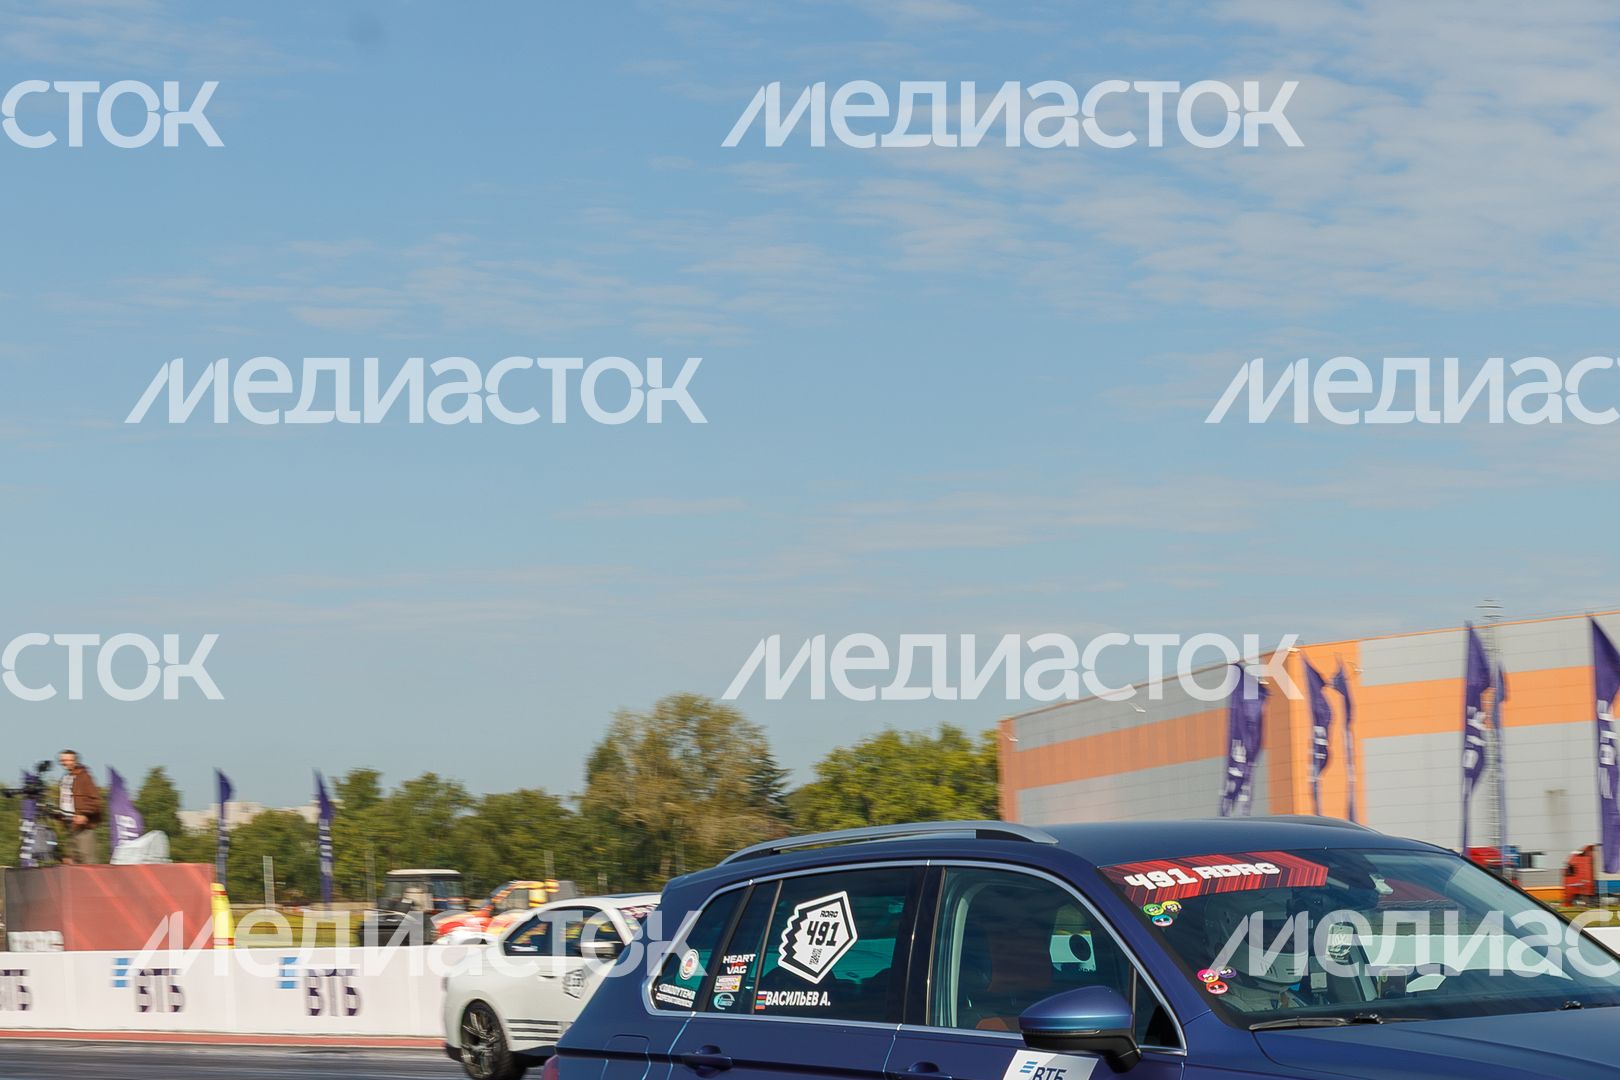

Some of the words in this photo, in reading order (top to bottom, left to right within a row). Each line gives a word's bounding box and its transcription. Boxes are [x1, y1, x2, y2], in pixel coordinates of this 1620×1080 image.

[1124, 868, 1198, 890] 491
[1192, 862, 1280, 880] RDRC
[806, 920, 840, 947] 491
[722, 953, 757, 964] HEART
[726, 965, 748, 975] VAG
[765, 990, 820, 1007] ВАСИЛЬЕВ
